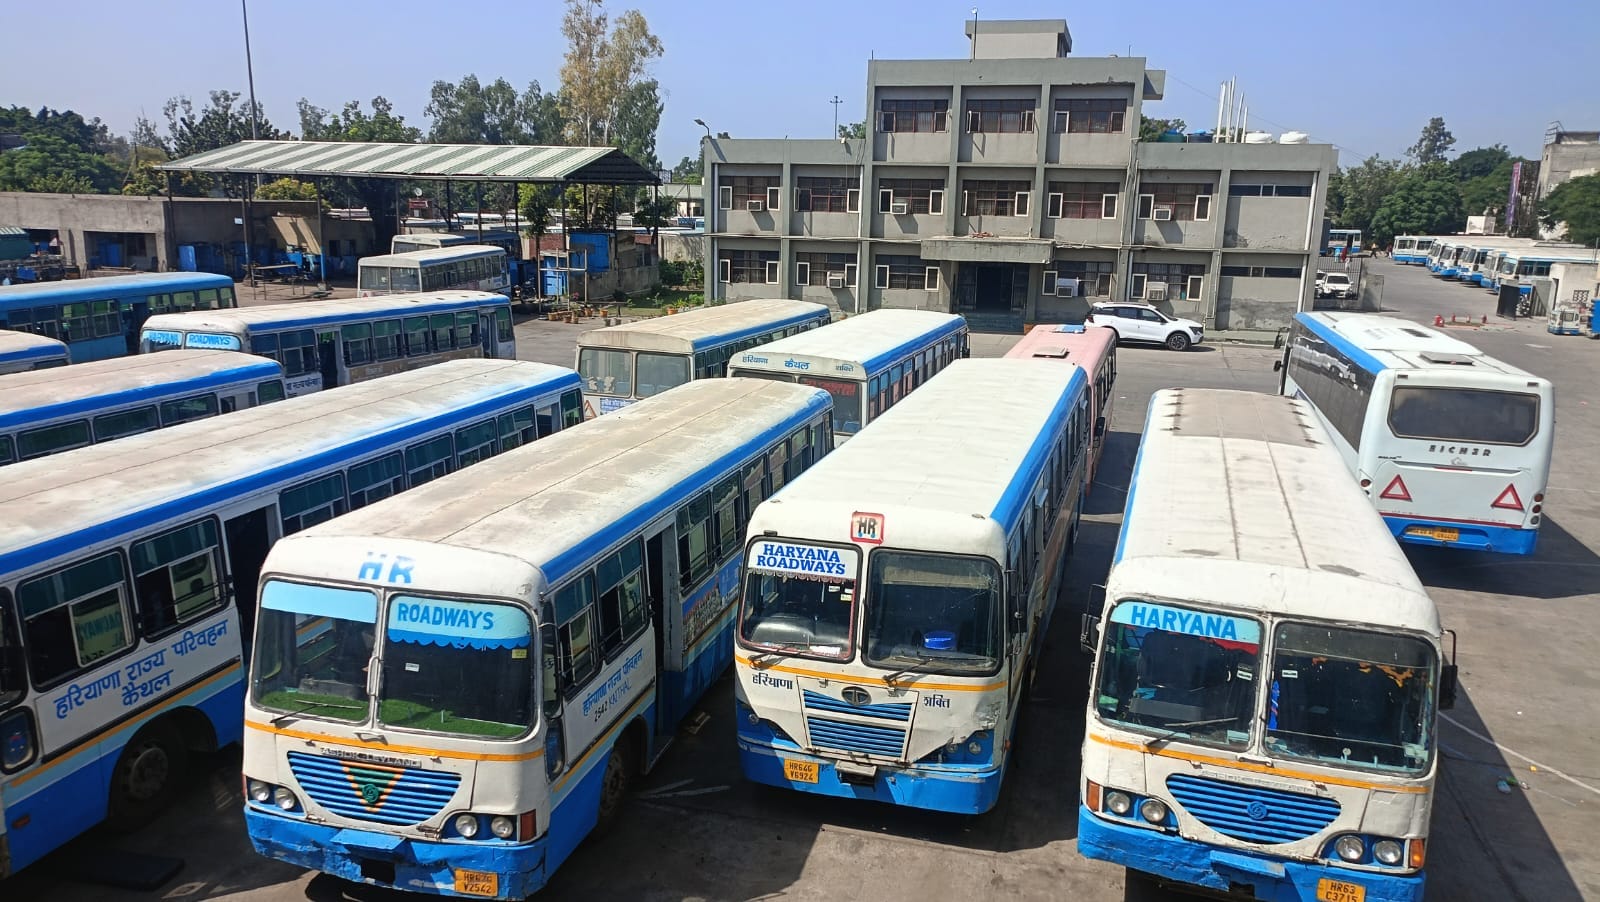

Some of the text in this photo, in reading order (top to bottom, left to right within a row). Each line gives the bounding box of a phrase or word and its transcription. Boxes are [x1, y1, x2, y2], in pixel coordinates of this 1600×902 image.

[189, 334, 231, 345] ROADWAYS
[784, 357, 810, 370] कैथल
[1429, 444, 1491, 457] EICHER
[856, 517, 878, 538] HR
[763, 543, 841, 562] HARYANA
[358, 551, 417, 584] HR
[757, 555, 845, 575] ROADWAYS
[397, 602, 494, 630] ROADWAYS
[1131, 605, 1238, 641] HARYANA
[53, 669, 121, 719] हरियाणा
[125, 648, 168, 680] राज्य
[171, 619, 229, 656] परिवहन
[122, 669, 174, 707] कैथल
[752, 671, 793, 690] हरियाणा
[594, 680, 631, 722] 2542 KAITHAL
[923, 694, 951, 709] शक्ति
[789, 762, 813, 773] HR64G
[790, 770, 813, 781] V6924
[464, 882, 492, 894] V2542
[1325, 890, 1359, 902] C3715
[1330, 882, 1356, 894] HR63
